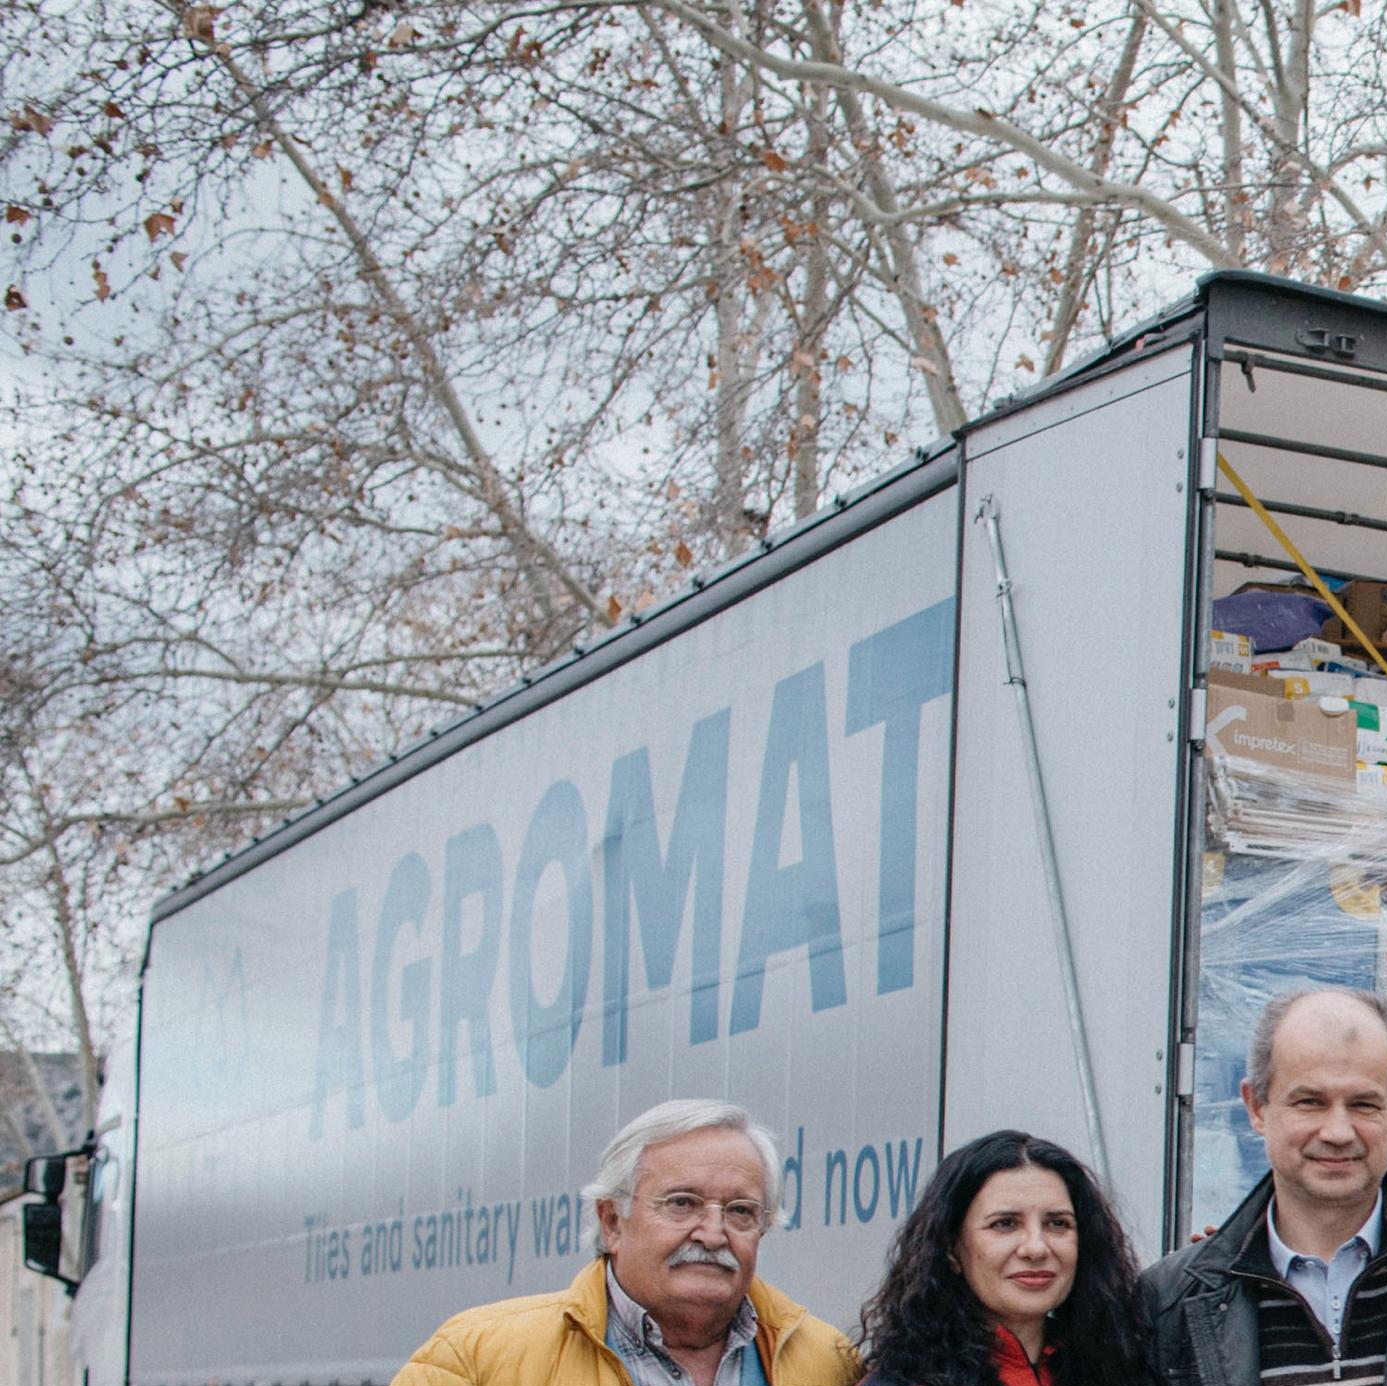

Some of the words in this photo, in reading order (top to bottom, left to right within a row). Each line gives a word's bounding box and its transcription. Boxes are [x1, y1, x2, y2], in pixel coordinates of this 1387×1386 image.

[308, 595, 957, 1142] AGROMAT
[360, 1195, 403, 1274] and
[411, 1185, 520, 1285] sanitary
[532, 1190, 586, 1258] war
[824, 1135, 925, 1229] now
